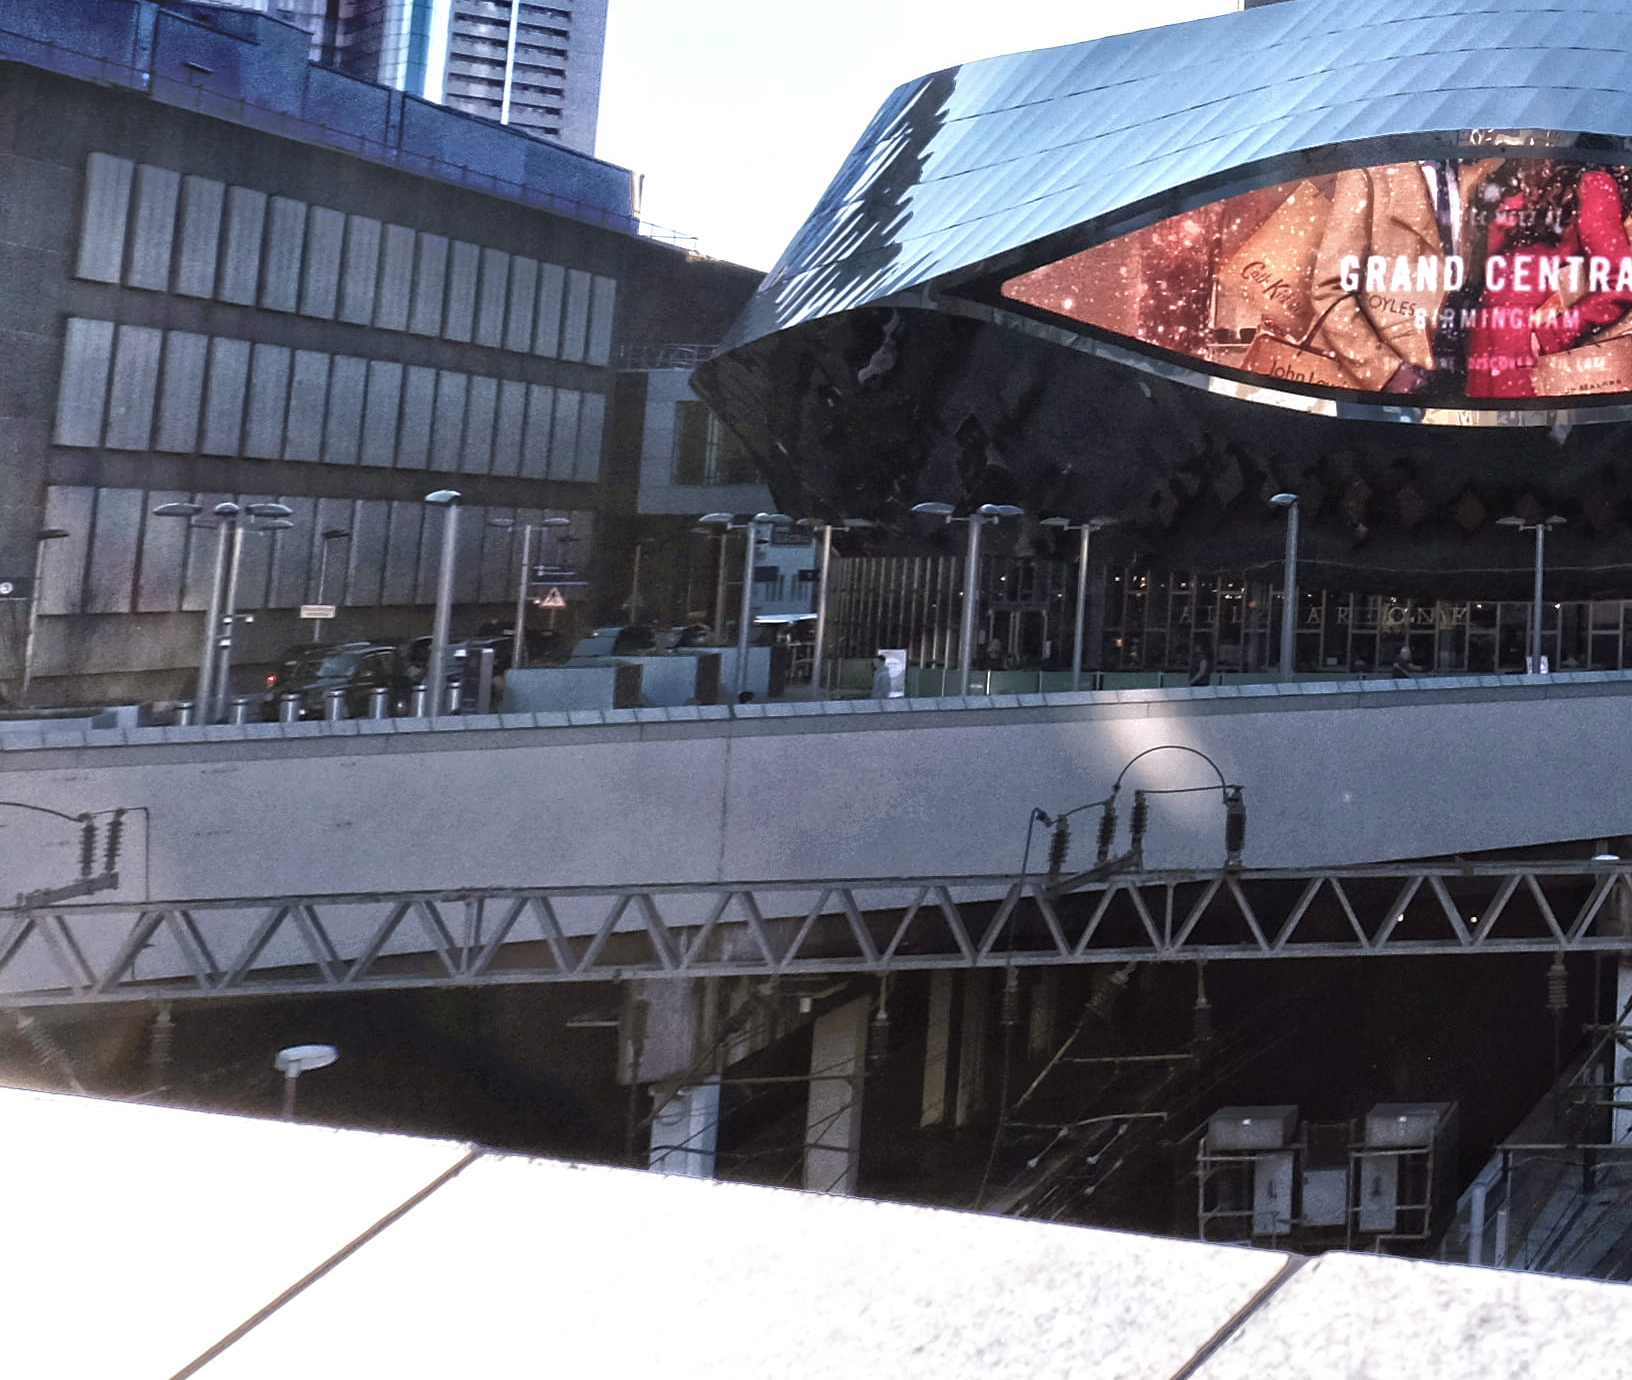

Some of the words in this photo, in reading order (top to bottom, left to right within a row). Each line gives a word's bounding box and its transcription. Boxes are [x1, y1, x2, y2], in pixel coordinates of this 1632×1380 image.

[1340, 255, 1465, 293] GRAND
[1368, 294, 1417, 317] OYLES
[1415, 306, 1580, 330] BIRMINGHAM
